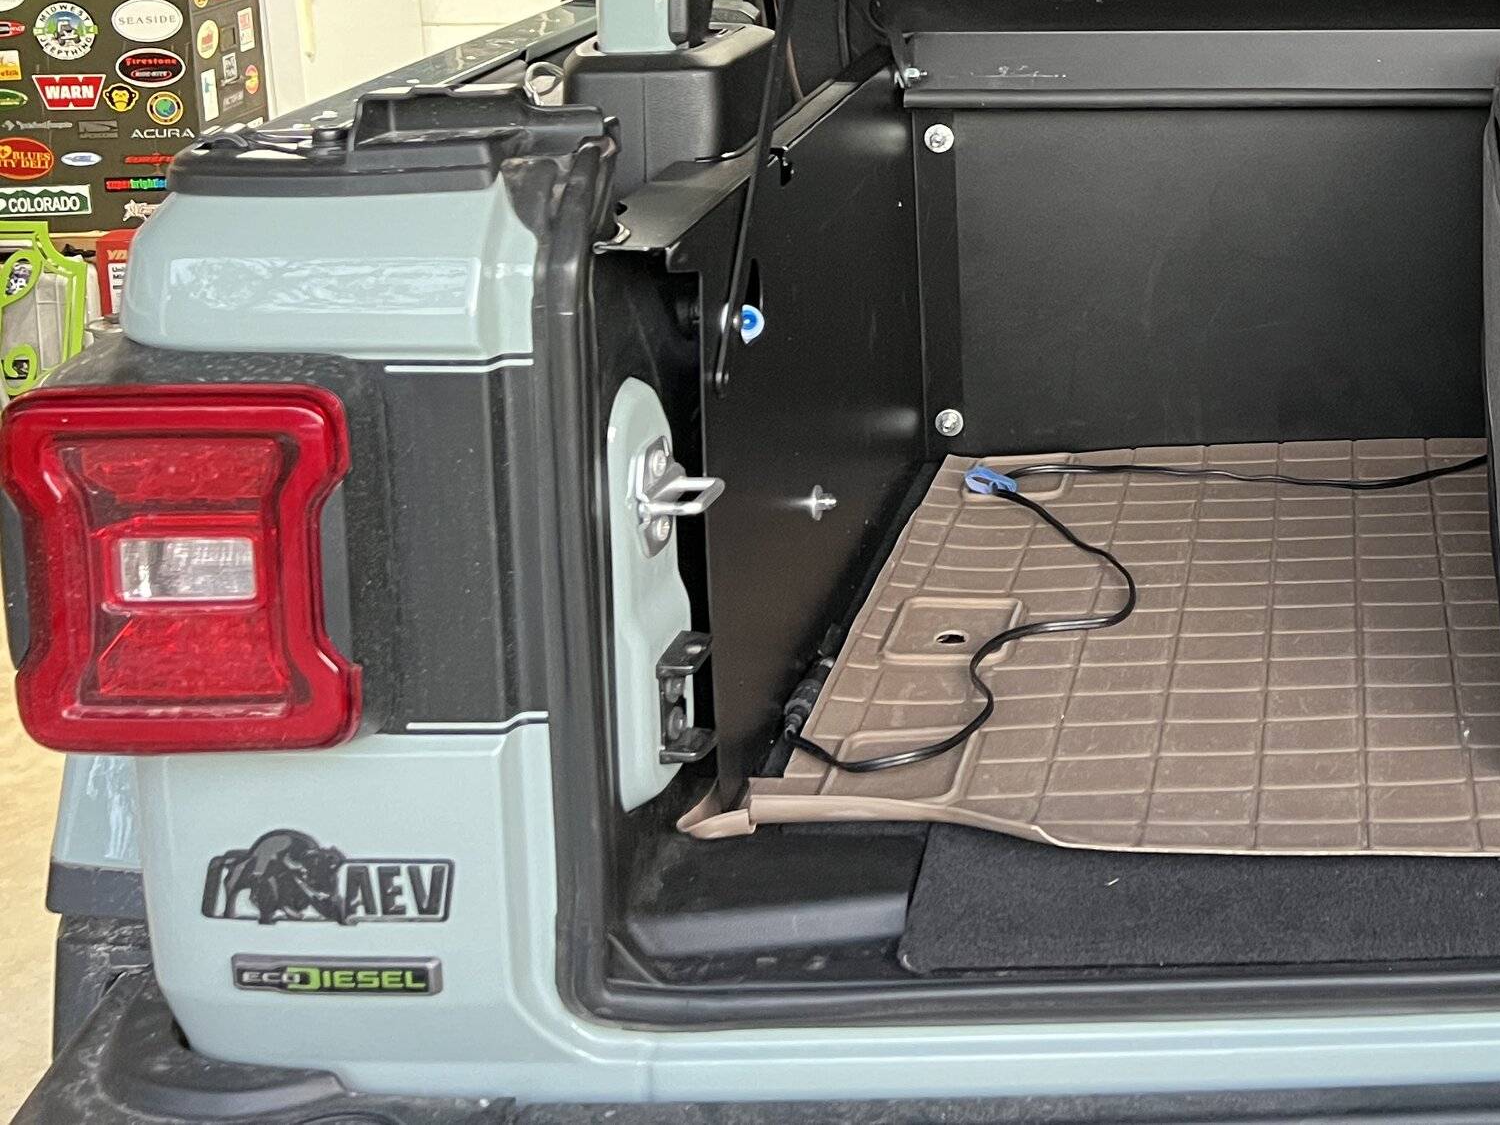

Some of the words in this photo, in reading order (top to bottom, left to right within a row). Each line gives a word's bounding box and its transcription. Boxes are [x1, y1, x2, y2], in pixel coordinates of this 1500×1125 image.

[39, 4, 91, 23] MIDWEST
[118, 14, 177, 26] SEASIDE
[39, 36, 93, 57] JEEPTHING
[125, 57, 177, 67] Firestone
[44, 84, 95, 100] WARN
[130, 127, 196, 139] ACURA
[12, 151, 51, 162] BLUES
[20, 157, 50, 169] DELI
[8, 195, 81, 213] COLORADO
[344, 865, 447, 916] AEV
